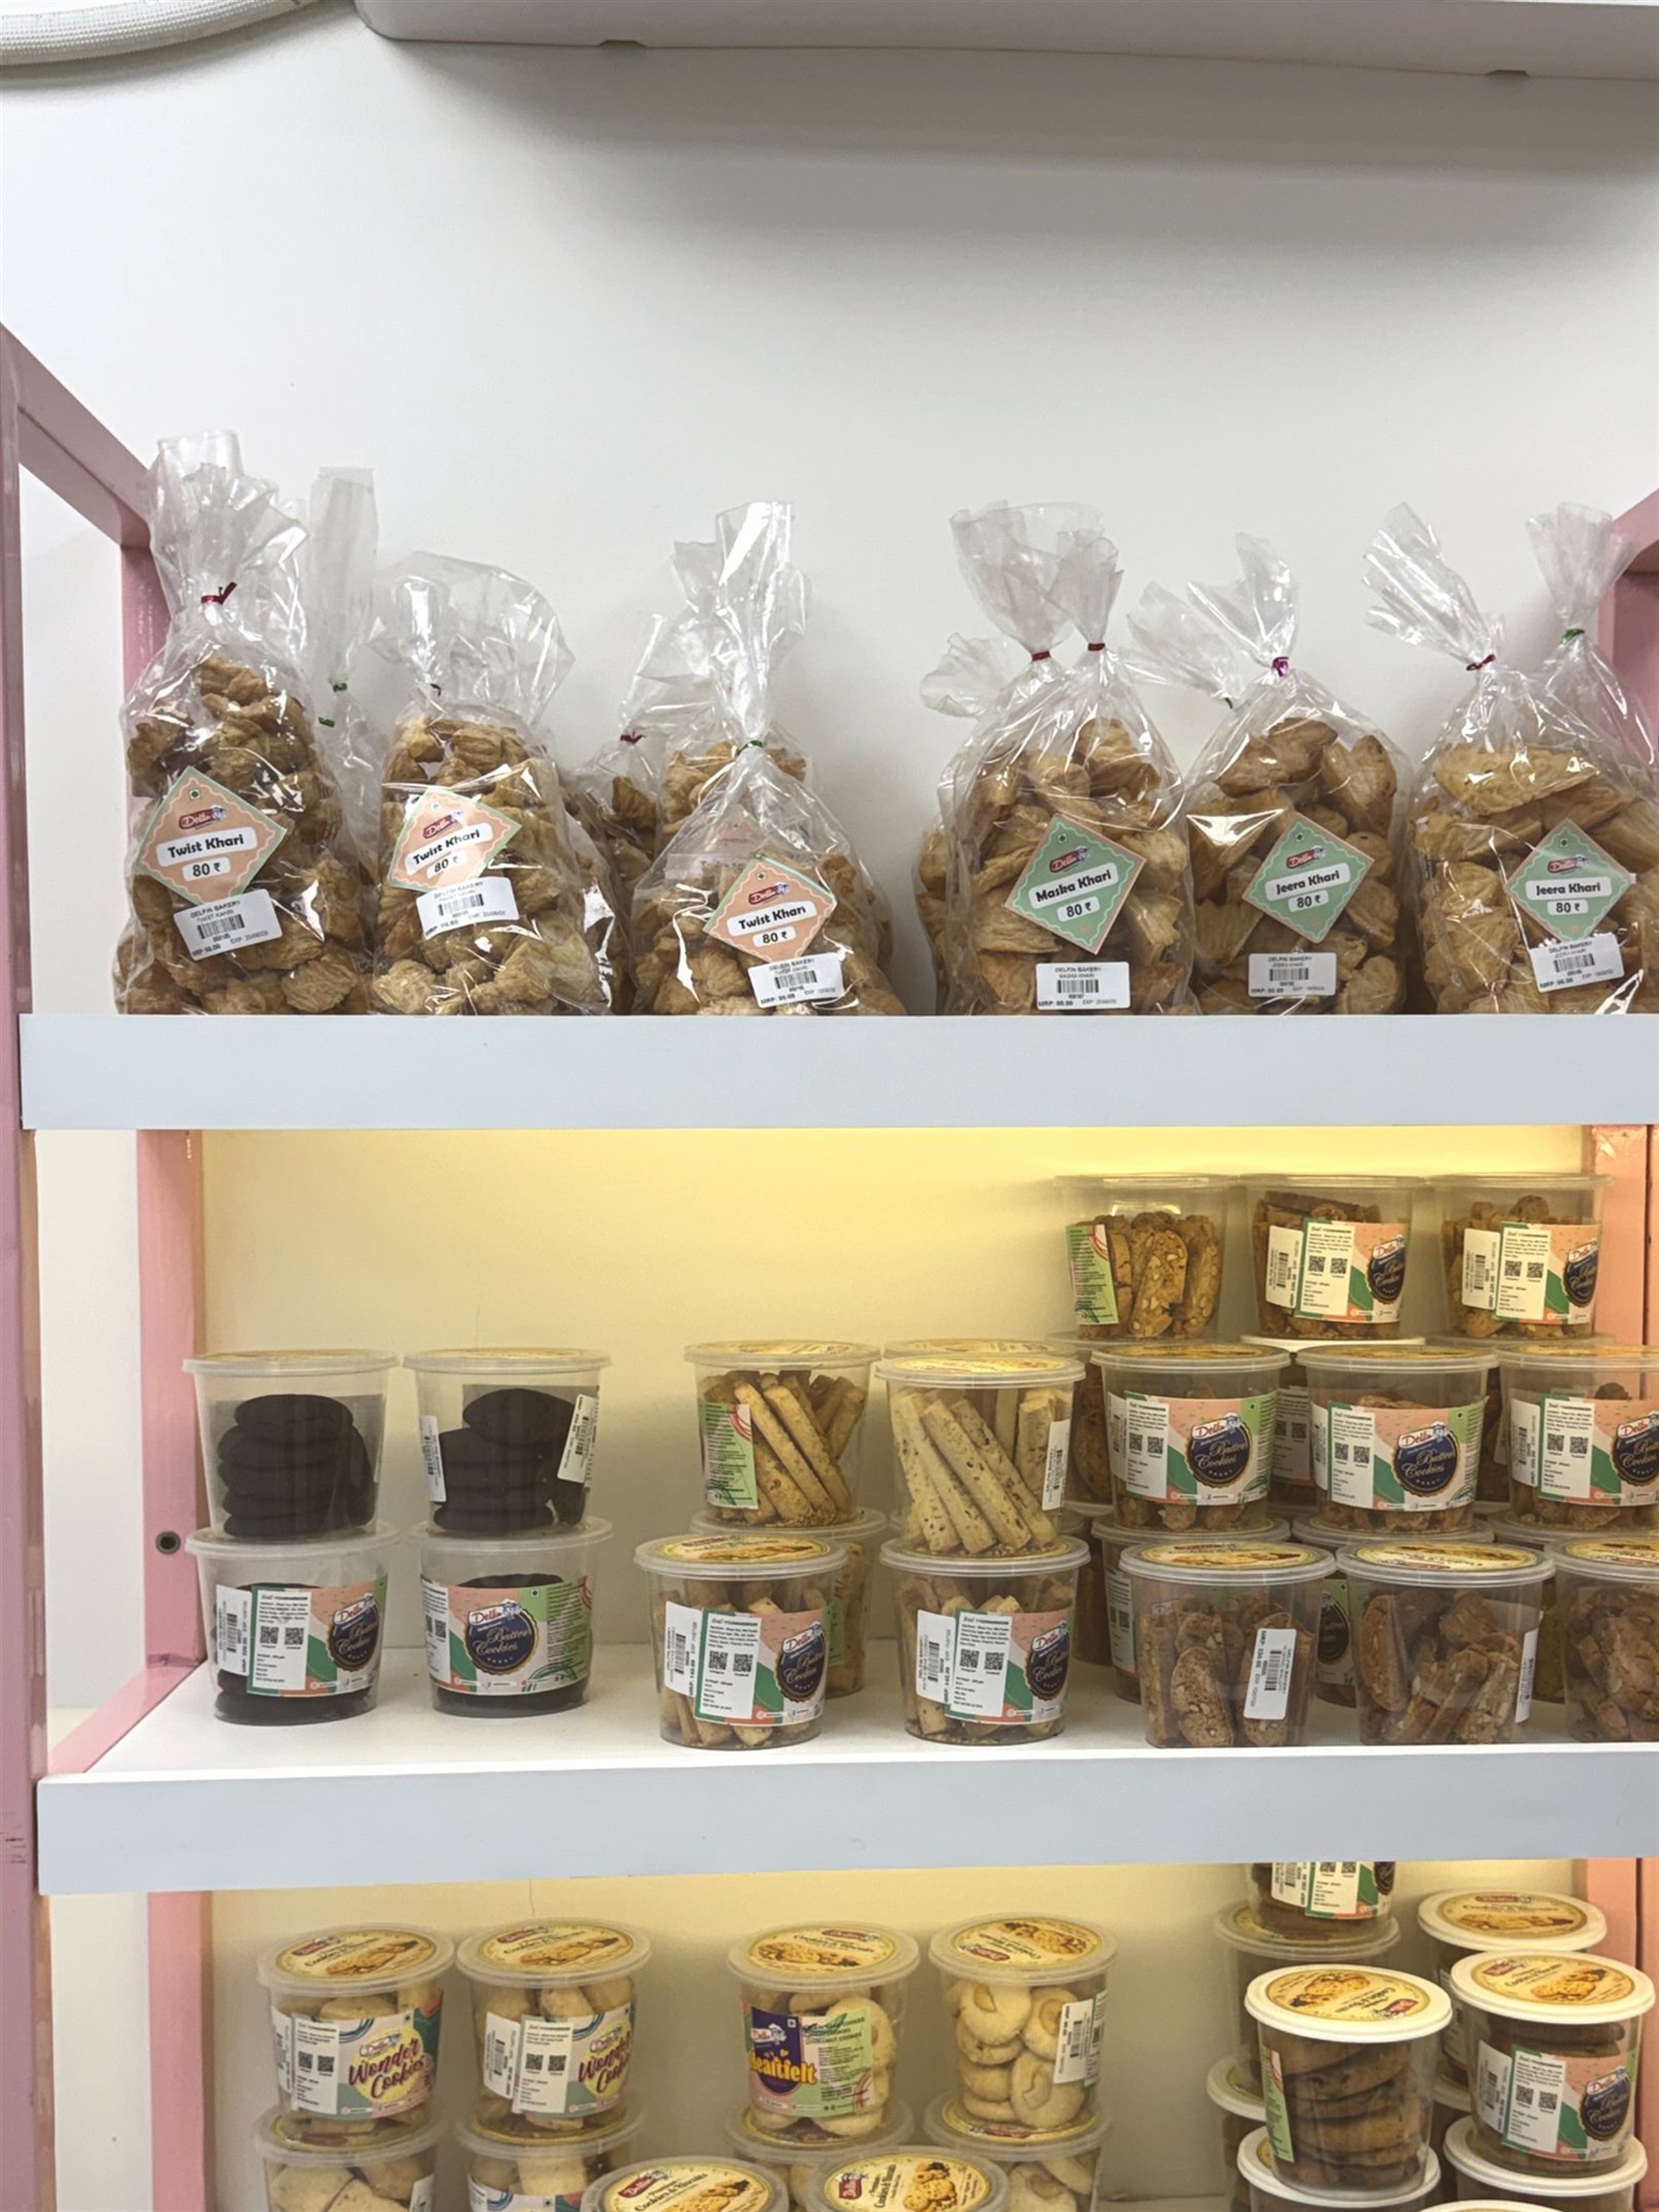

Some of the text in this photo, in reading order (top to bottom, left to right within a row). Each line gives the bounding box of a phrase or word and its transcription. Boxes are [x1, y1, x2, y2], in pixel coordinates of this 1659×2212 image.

[168, 834, 244, 858] Twist Khari
[413, 830, 480, 865] Twist Khari
[193, 863, 211, 877] 80
[434, 859, 449, 873] 80
[1035, 869, 1111, 903] Maska Khari
[1276, 870, 1340, 894] Jeera Khari
[1535, 882, 1600, 896] Jeera Khari
[1066, 904, 1083, 918] 80
[1296, 896, 1313, 908] 80
[1555, 903, 1571, 913] 80
[738, 906, 806, 930] Twist Khari
[762, 932, 778, 944] 80
[348, 2037, 420, 2085] Wonder
[371, 2056, 424, 2099] Cookies
